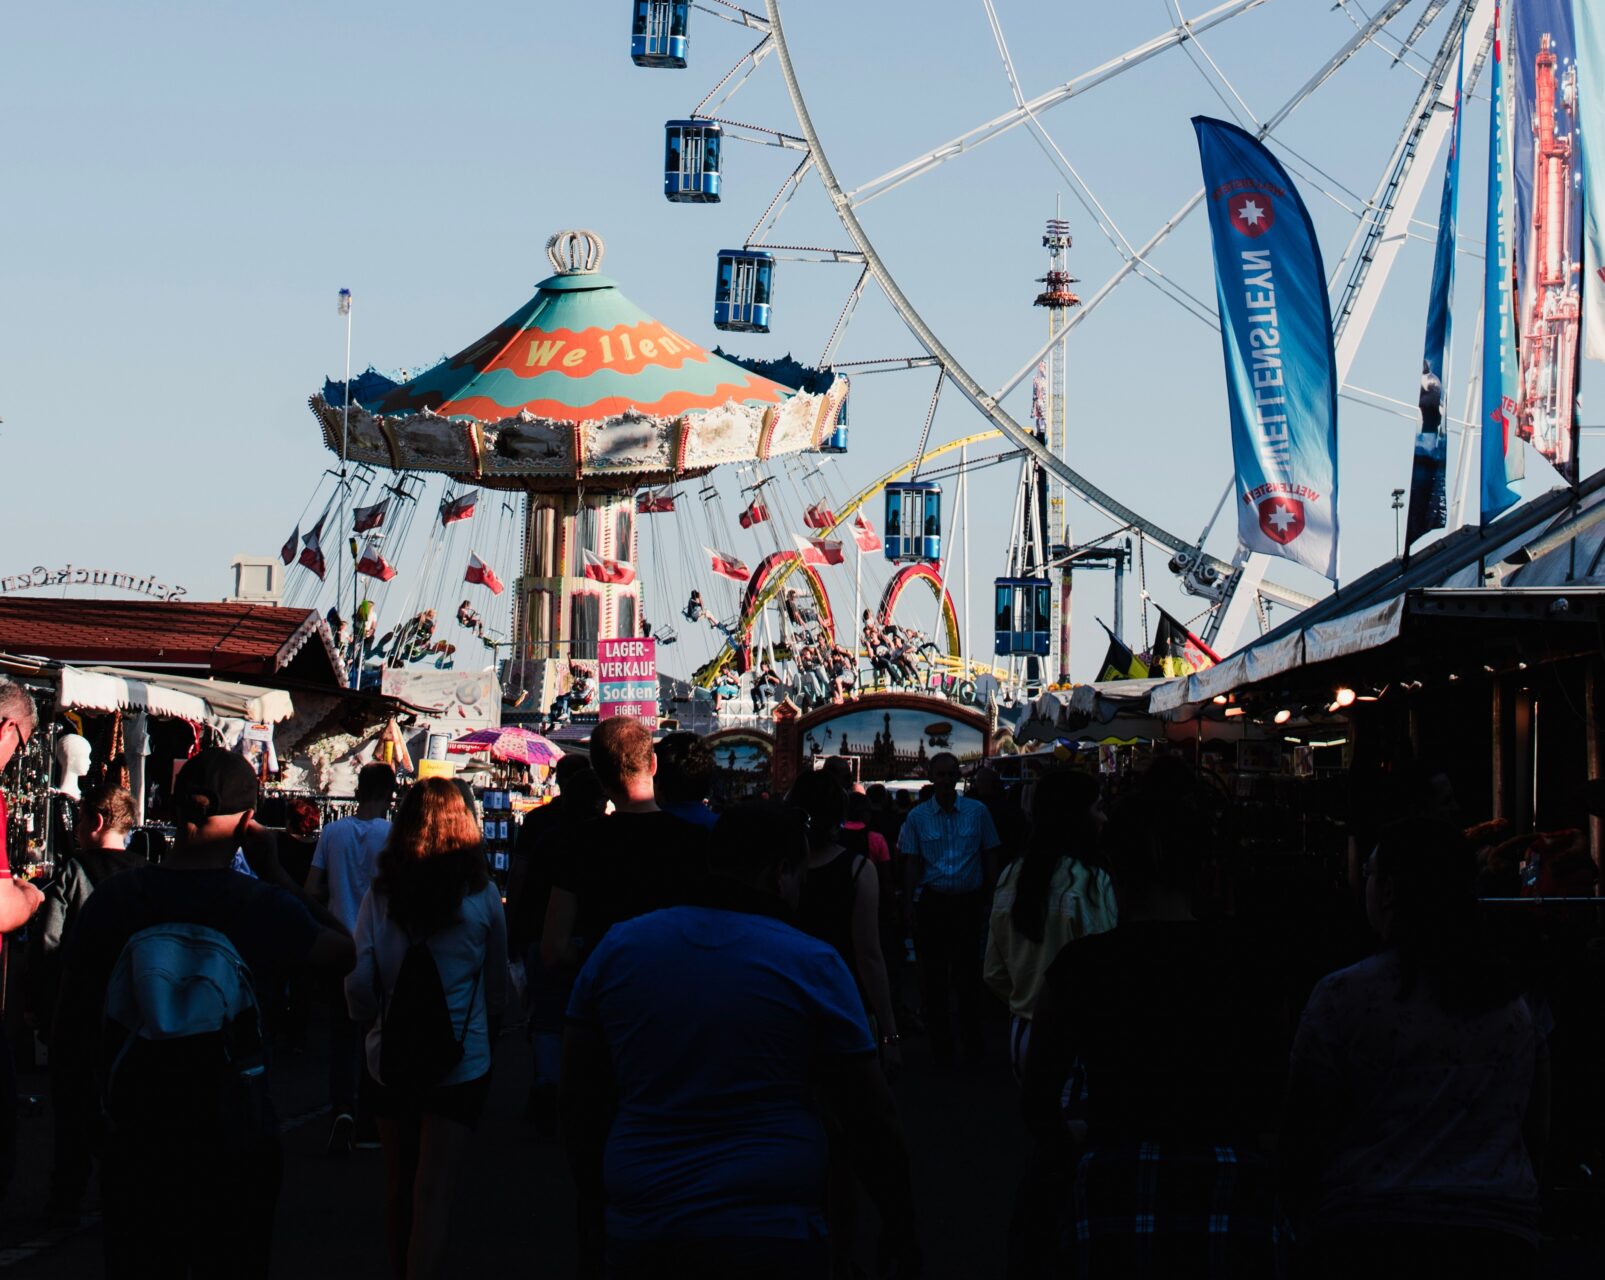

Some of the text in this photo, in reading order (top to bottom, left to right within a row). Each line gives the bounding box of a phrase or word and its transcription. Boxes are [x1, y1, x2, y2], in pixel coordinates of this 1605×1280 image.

[605, 641, 650, 658] LAGER-
[600, 661, 655, 678] VERKAUF
[603, 683, 653, 700] Socken
[614, 704, 642, 716] EIGENE
